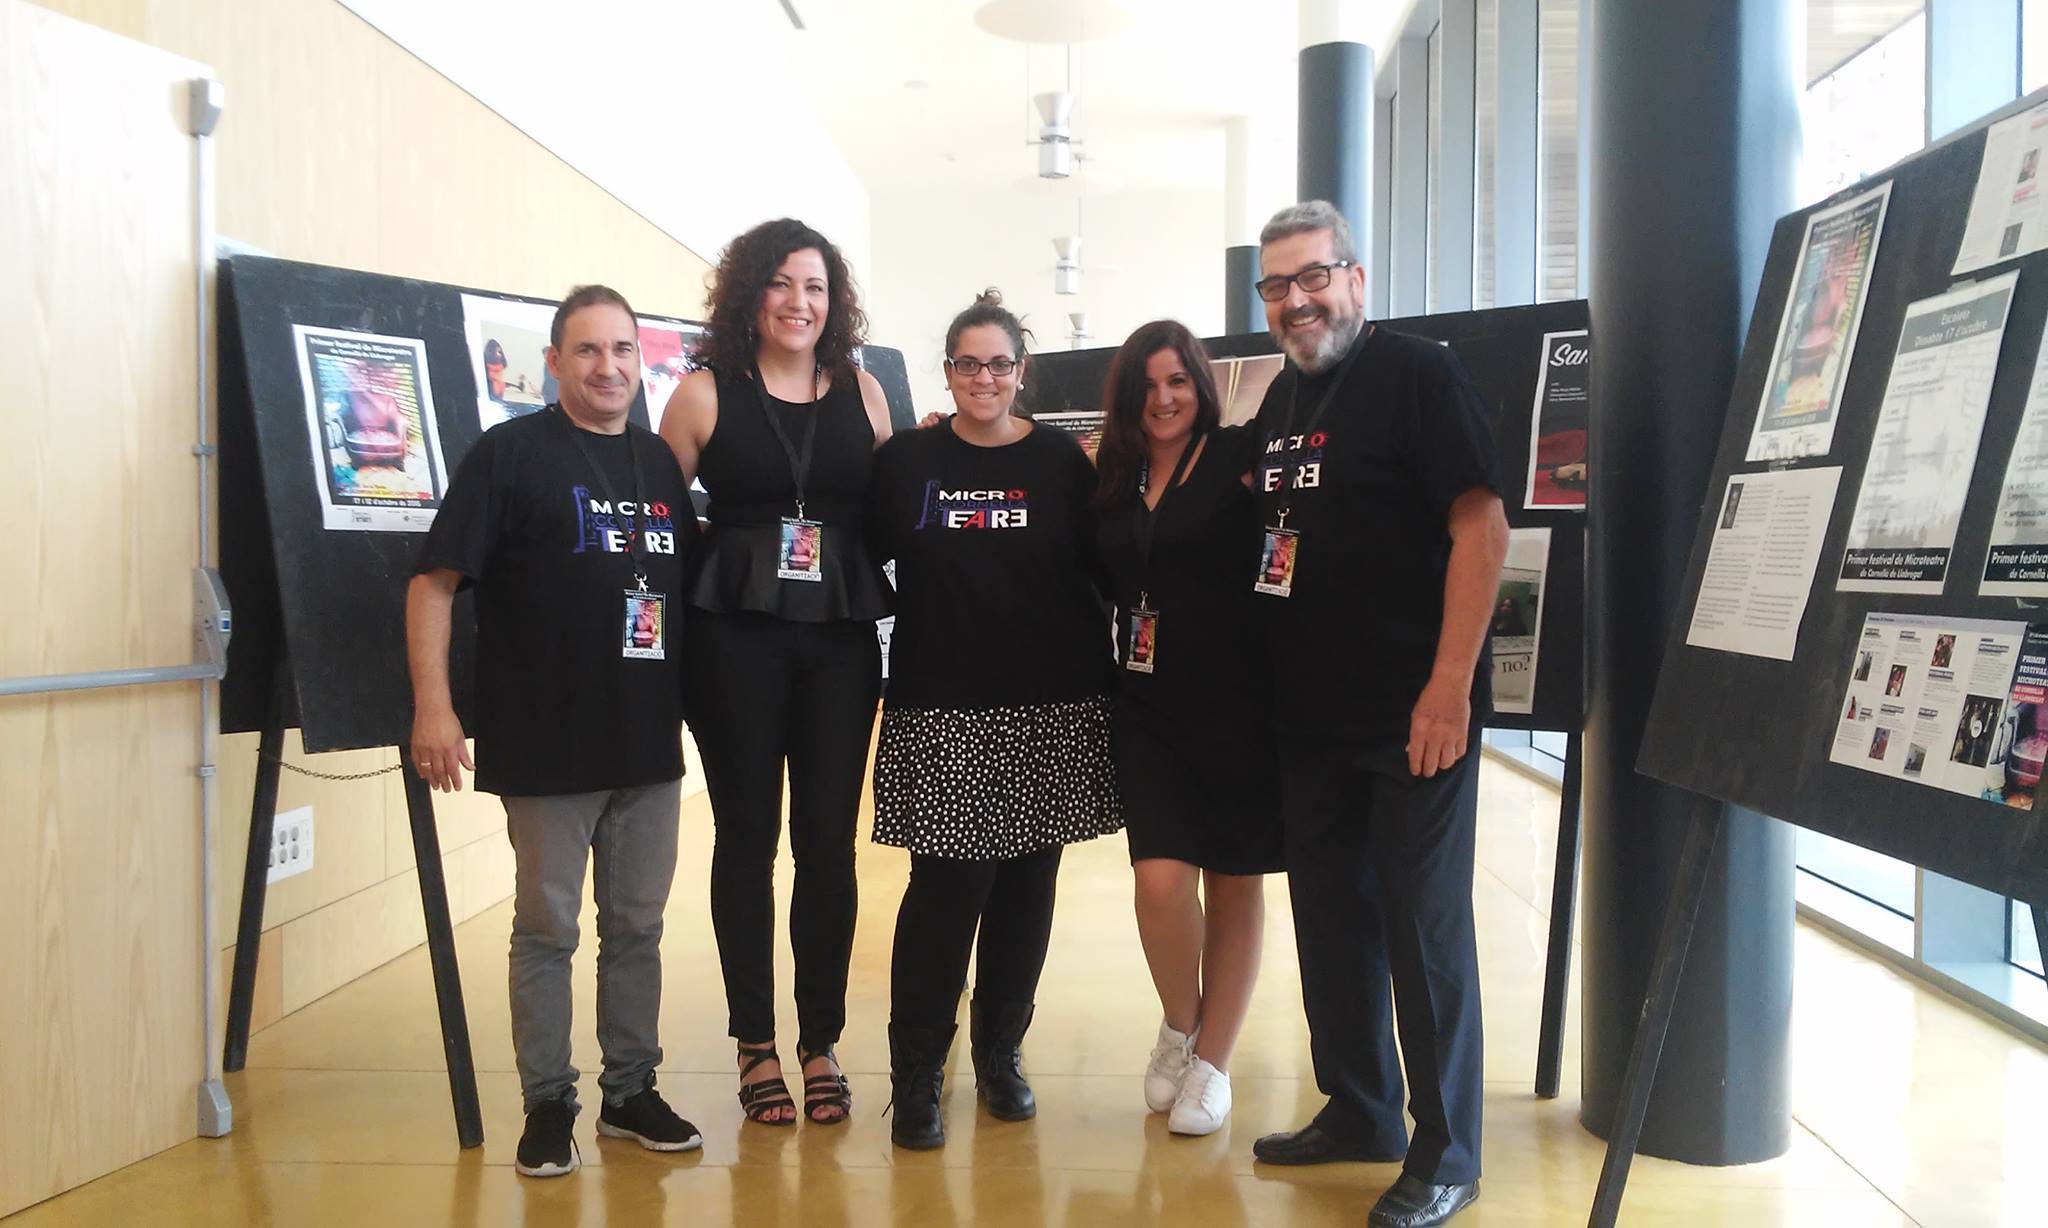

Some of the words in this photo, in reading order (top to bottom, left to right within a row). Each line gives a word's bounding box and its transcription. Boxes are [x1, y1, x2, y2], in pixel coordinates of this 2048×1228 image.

[938, 488, 1025, 501] MICRO
[1846, 553, 1869, 565] Primer
[1868, 553, 1895, 565] festival
[1894, 553, 1904, 565] de
[1904, 553, 1945, 565] Microteatre
[1991, 551, 2019, 564] Primer
[2009, 568, 2018, 579] de
[1501, 655, 1531, 673] no?
[2022, 655, 2046, 664] PRIMER
